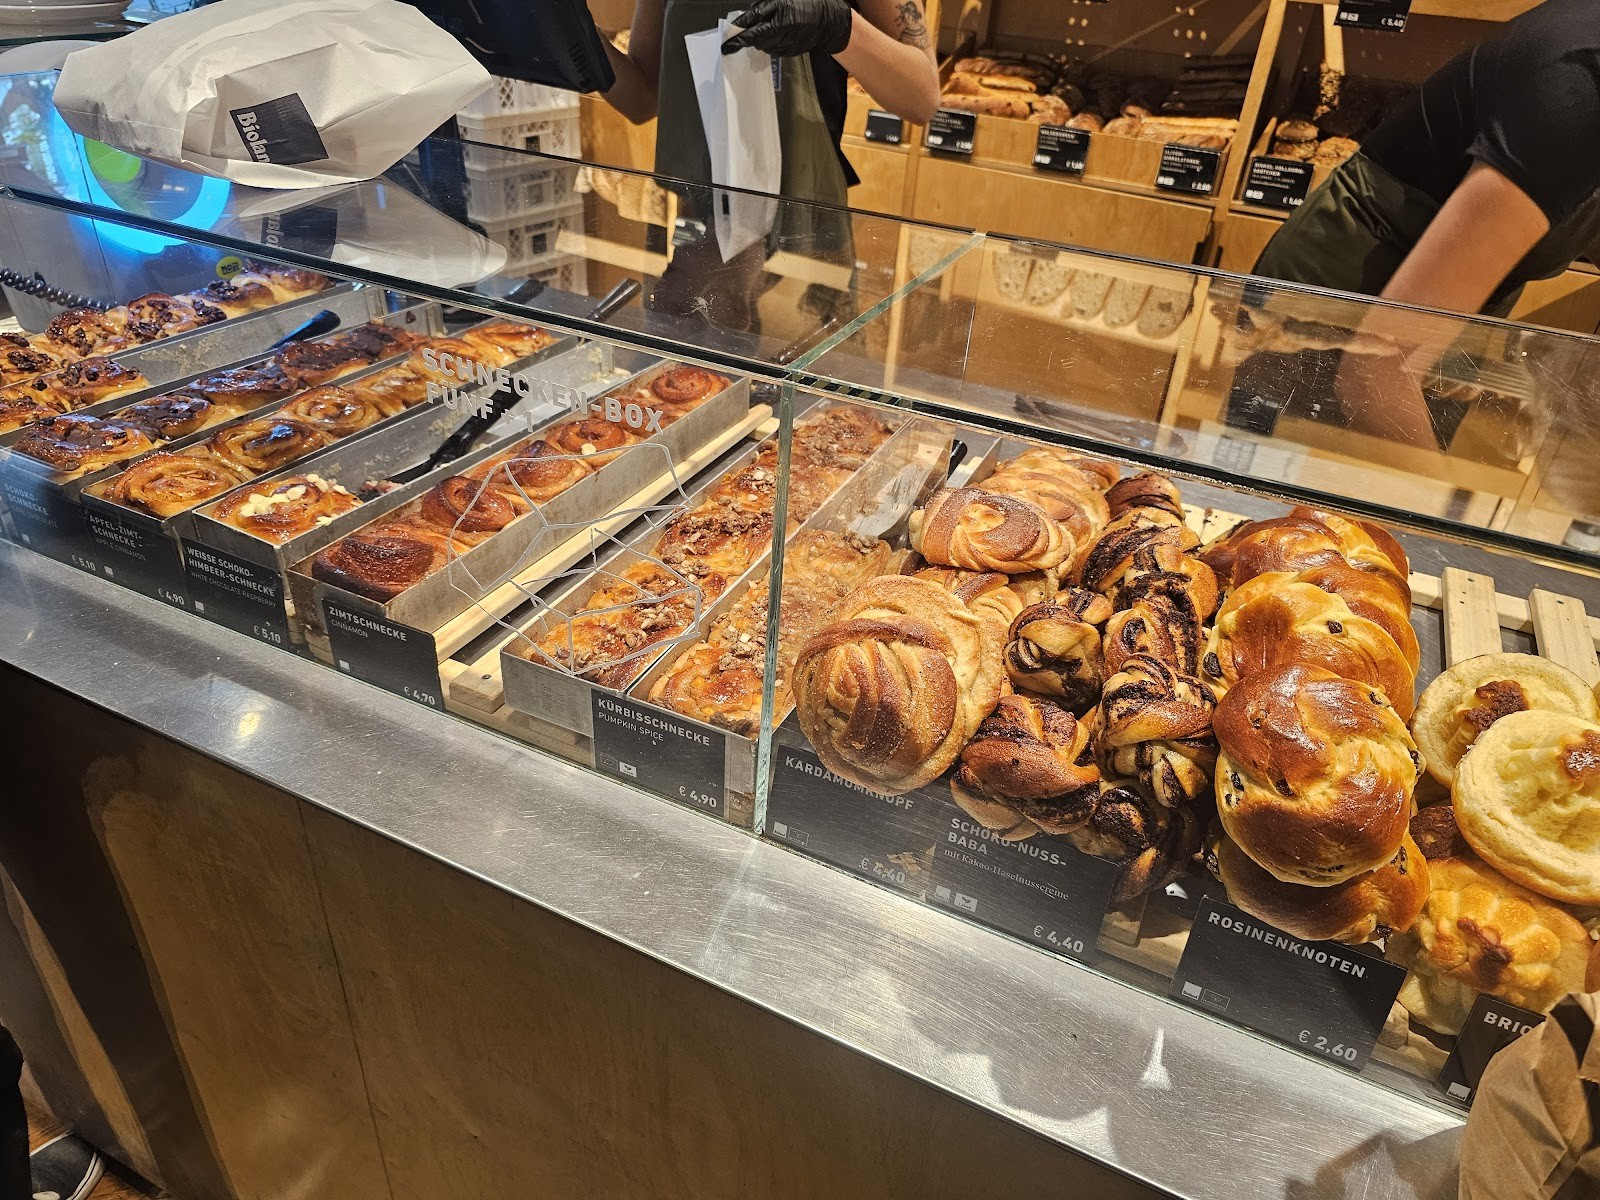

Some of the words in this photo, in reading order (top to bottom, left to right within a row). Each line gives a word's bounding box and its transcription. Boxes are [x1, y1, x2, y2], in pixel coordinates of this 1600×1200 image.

[421, 347, 664, 435] SCHNECKEN-BOX
[425, 380, 494, 420] FÜNF
[520, 410, 534, 433] 1
[7, 493, 49, 516] SCHNECKE
[89, 514, 143, 540] APFEL-ZIMT-
[92, 525, 136, 548] SCHNECKE
[187, 546, 217, 564] WEISSE
[218, 558, 253, 577] SCHOKO-
[188, 557, 275, 597] HIMBEER-SCHNECKE
[191, 571, 208, 583] WHITE
[208, 577, 242, 596] CHOCOLATE
[242, 590, 276, 608] RASPBERRY
[253, 625, 260, 635] €
[329, 606, 407, 642] ZIMTSCHNECKE
[331, 619, 369, 638] CINNAMON
[404, 686, 411, 696] €
[598, 698, 710, 746] KÜRBISSCHNECKE
[598, 711, 637, 731] PUMPKIN
[639, 727, 664, 741] SPICE
[679, 786, 686, 797] €
[947, 831, 988, 855] BABA
[951, 817, 1067, 866] SCHOKO-NUSS-
[860, 857, 870, 870] €
[944, 849, 960, 860] mit
[962, 854, 1069, 900] Kakao-Haselnusscreme
[1033, 925, 1044, 938] €
[1046, 930, 1084, 953] 4,40
[1208, 911, 1366, 978] ROSINENKNOTEN
[1298, 1029, 1311, 1043] €
[1313, 1036, 1358, 1061] 2,60
